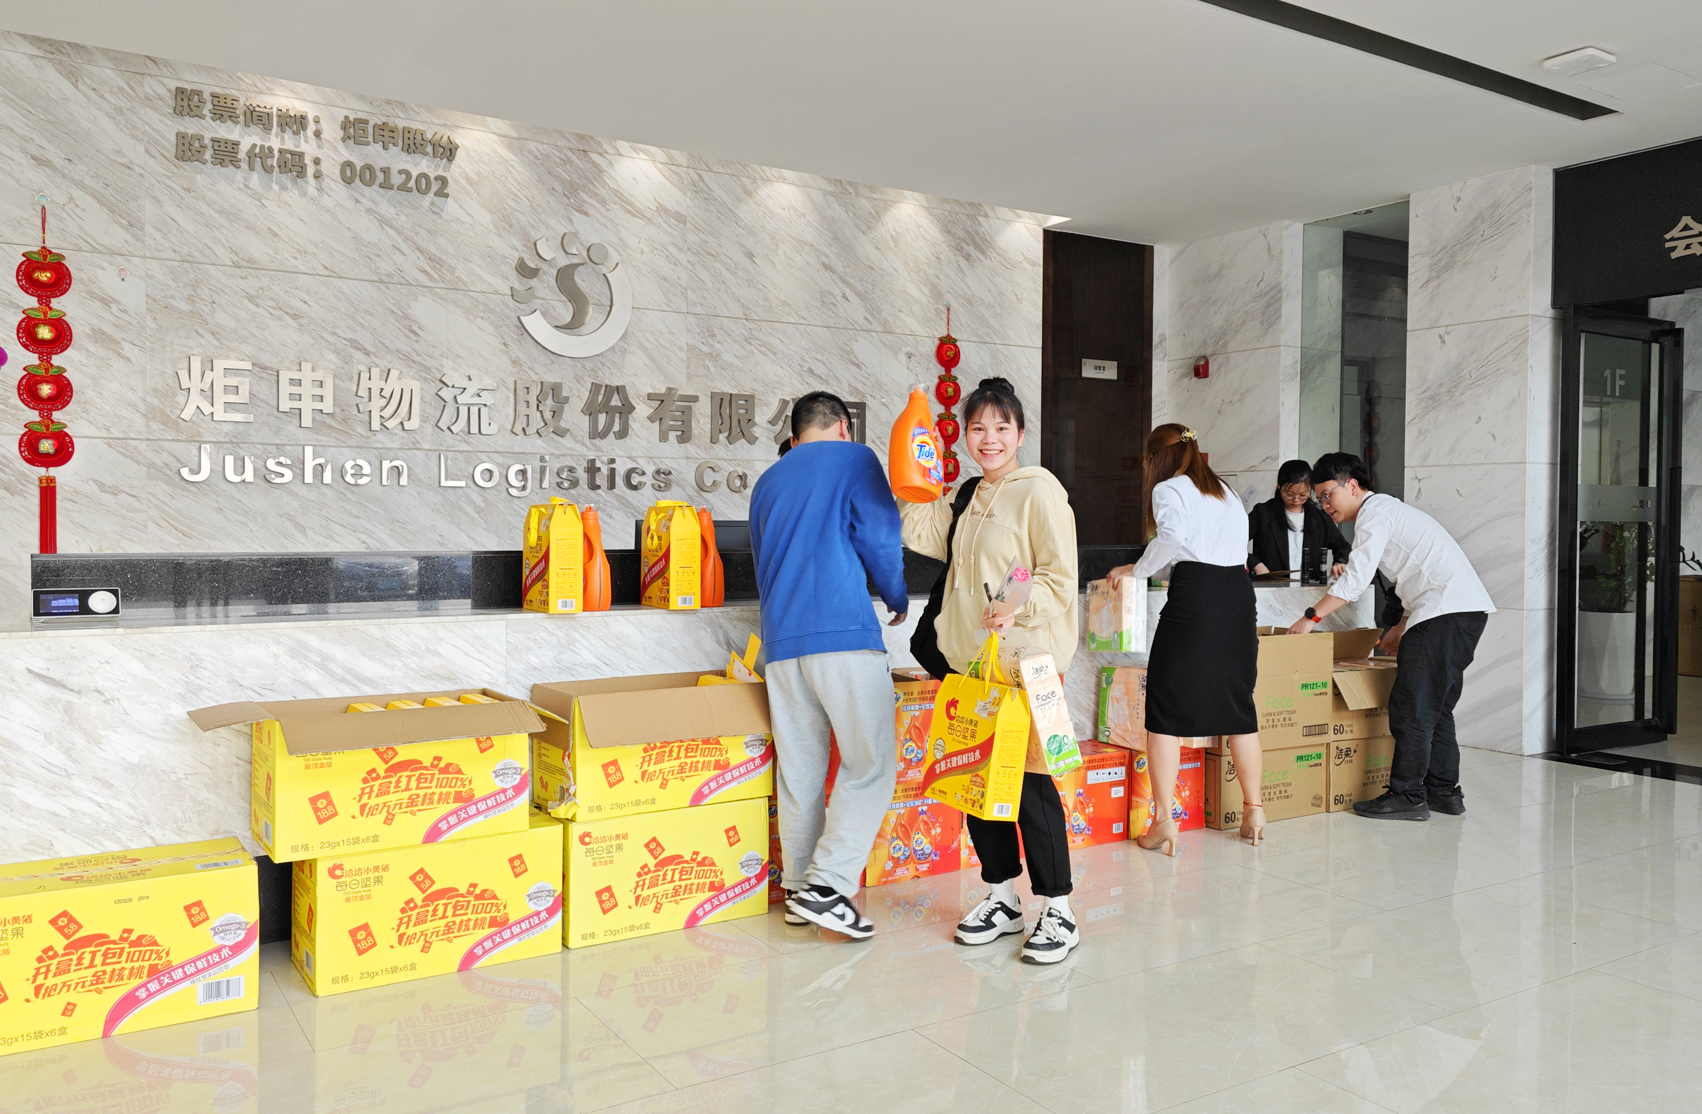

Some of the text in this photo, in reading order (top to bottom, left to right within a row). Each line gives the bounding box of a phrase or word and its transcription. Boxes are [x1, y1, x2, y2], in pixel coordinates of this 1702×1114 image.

[1603, 369, 1626, 396] 1F
[916, 444, 935, 459] Tide
[179, 444, 408, 487] Jushen
[440, 453, 673, 498] Logistics
[1036, 690, 1057, 704] Face
[1301, 682, 1328, 691] PR121-10
[1266, 696, 1293, 709] Face
[1333, 724, 1344, 735] 60
[640, 743, 726, 770] 开盒红包100%
[1135, 759, 1147, 770] Tide
[1296, 753, 1322, 762] PR121-10
[1367, 755, 1389, 768] Face
[645, 760, 713, 783] 抢万元金核桃
[1262, 769, 1289, 784] Face
[357, 772, 467, 803] 开盒红包100%
[1334, 794, 1344, 805] 60
[366, 791, 453, 818] 抢万元金核桃
[438, 788, 516, 832] 掌握关键保鲜技术
[1225, 811, 1236, 824] 60
[335, 875, 384, 892] 每日坚果
[633, 866, 720, 894] 开盒红包100%
[639, 882, 708, 909] 抢万元金核桃
[215, 922, 246, 933] Omega-3
[396, 899, 503, 933] 开盒红包100%
[404, 916, 487, 947] 抢万元金核桃
[473, 911, 549, 956] 掌握关键保鲜技术
[31, 944, 166, 984] 开盒红包100%
[135, 947, 232, 1000] 掌握关键保鲜技术
[42, 965, 146, 999] 抢万元金核桃
